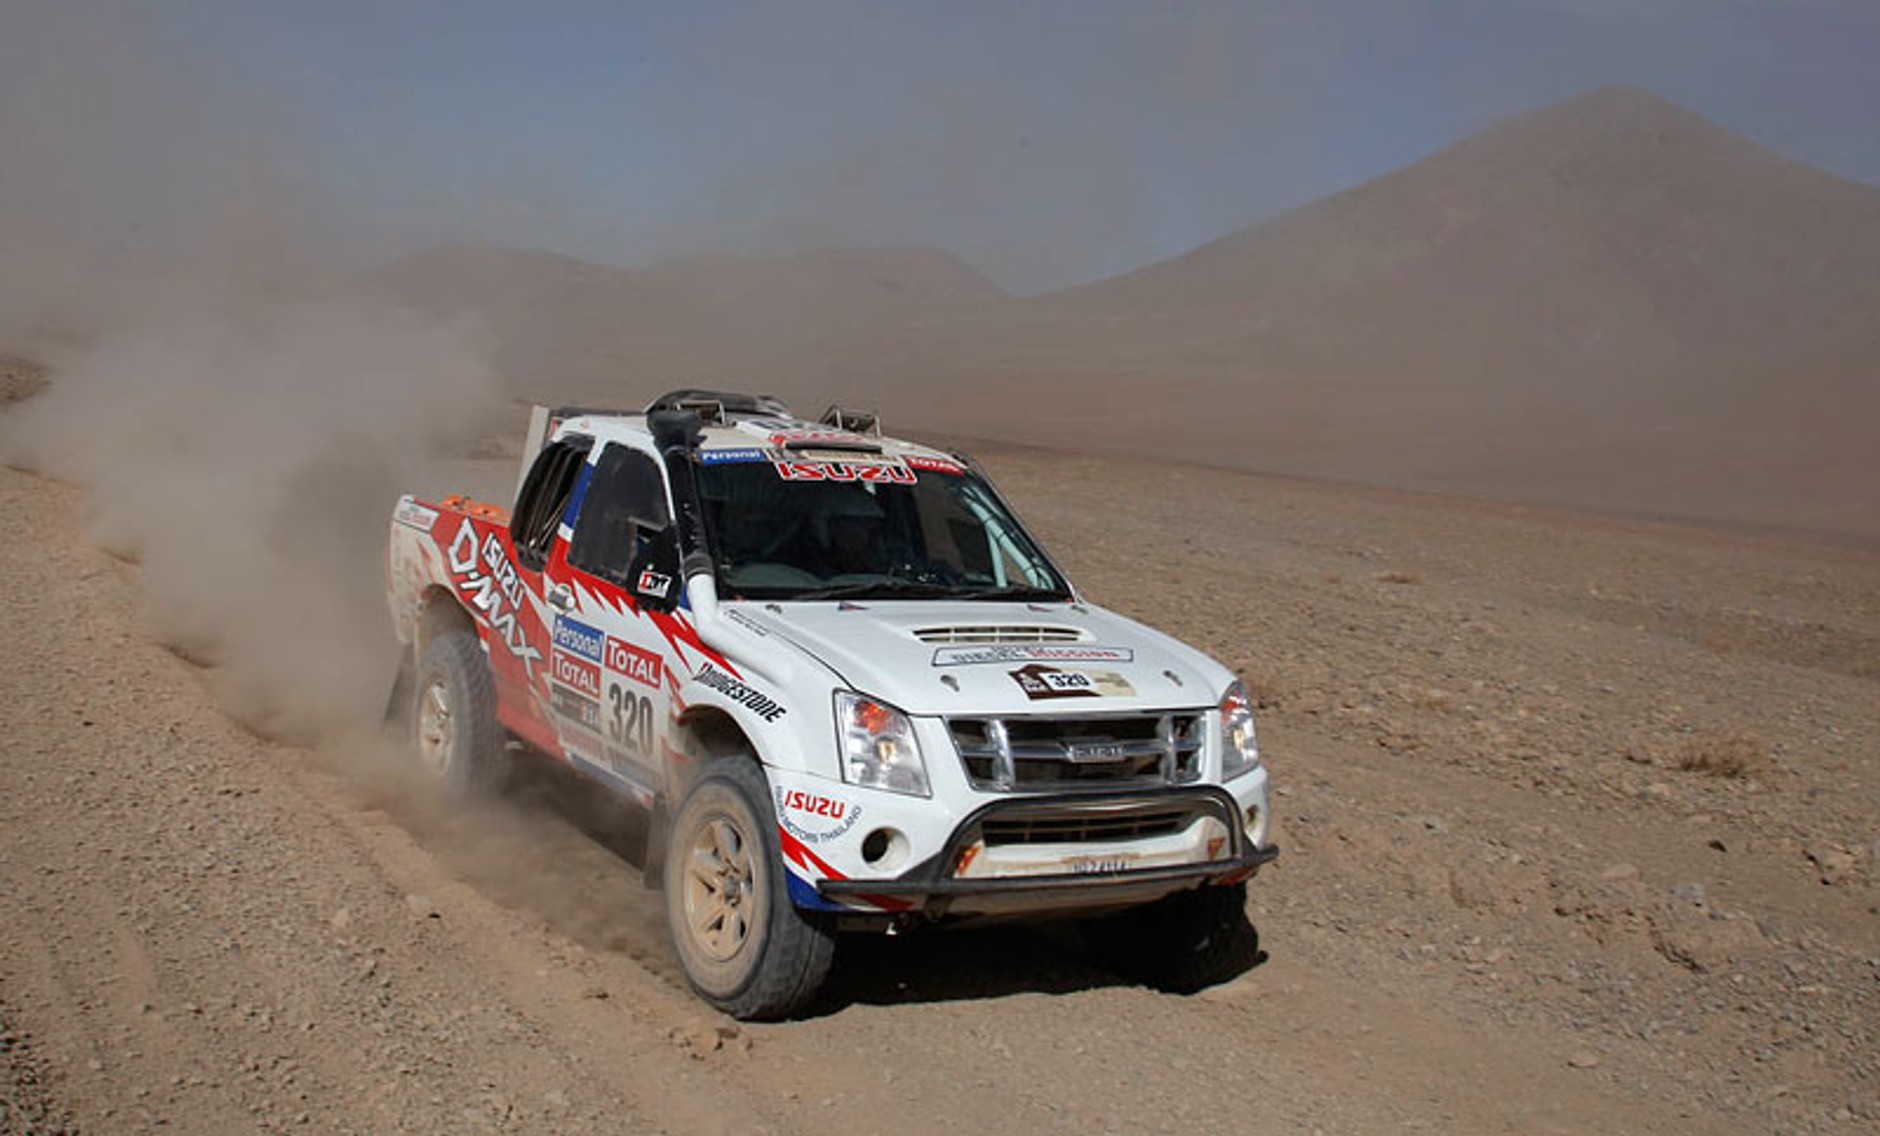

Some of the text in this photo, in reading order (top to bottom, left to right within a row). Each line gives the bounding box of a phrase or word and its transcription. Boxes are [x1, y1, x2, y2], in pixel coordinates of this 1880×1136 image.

[701, 449, 761, 461] Personal
[777, 461, 918, 483] ISUZU
[482, 531, 526, 611] ISUZU
[554, 618, 603, 659] Personal
[554, 651, 599, 694] TOTAL
[608, 639, 660, 684] TOTAL
[1048, 673, 1090, 688] 320
[608, 682, 654, 756] 320
[784, 790, 845, 819] ISUZU
